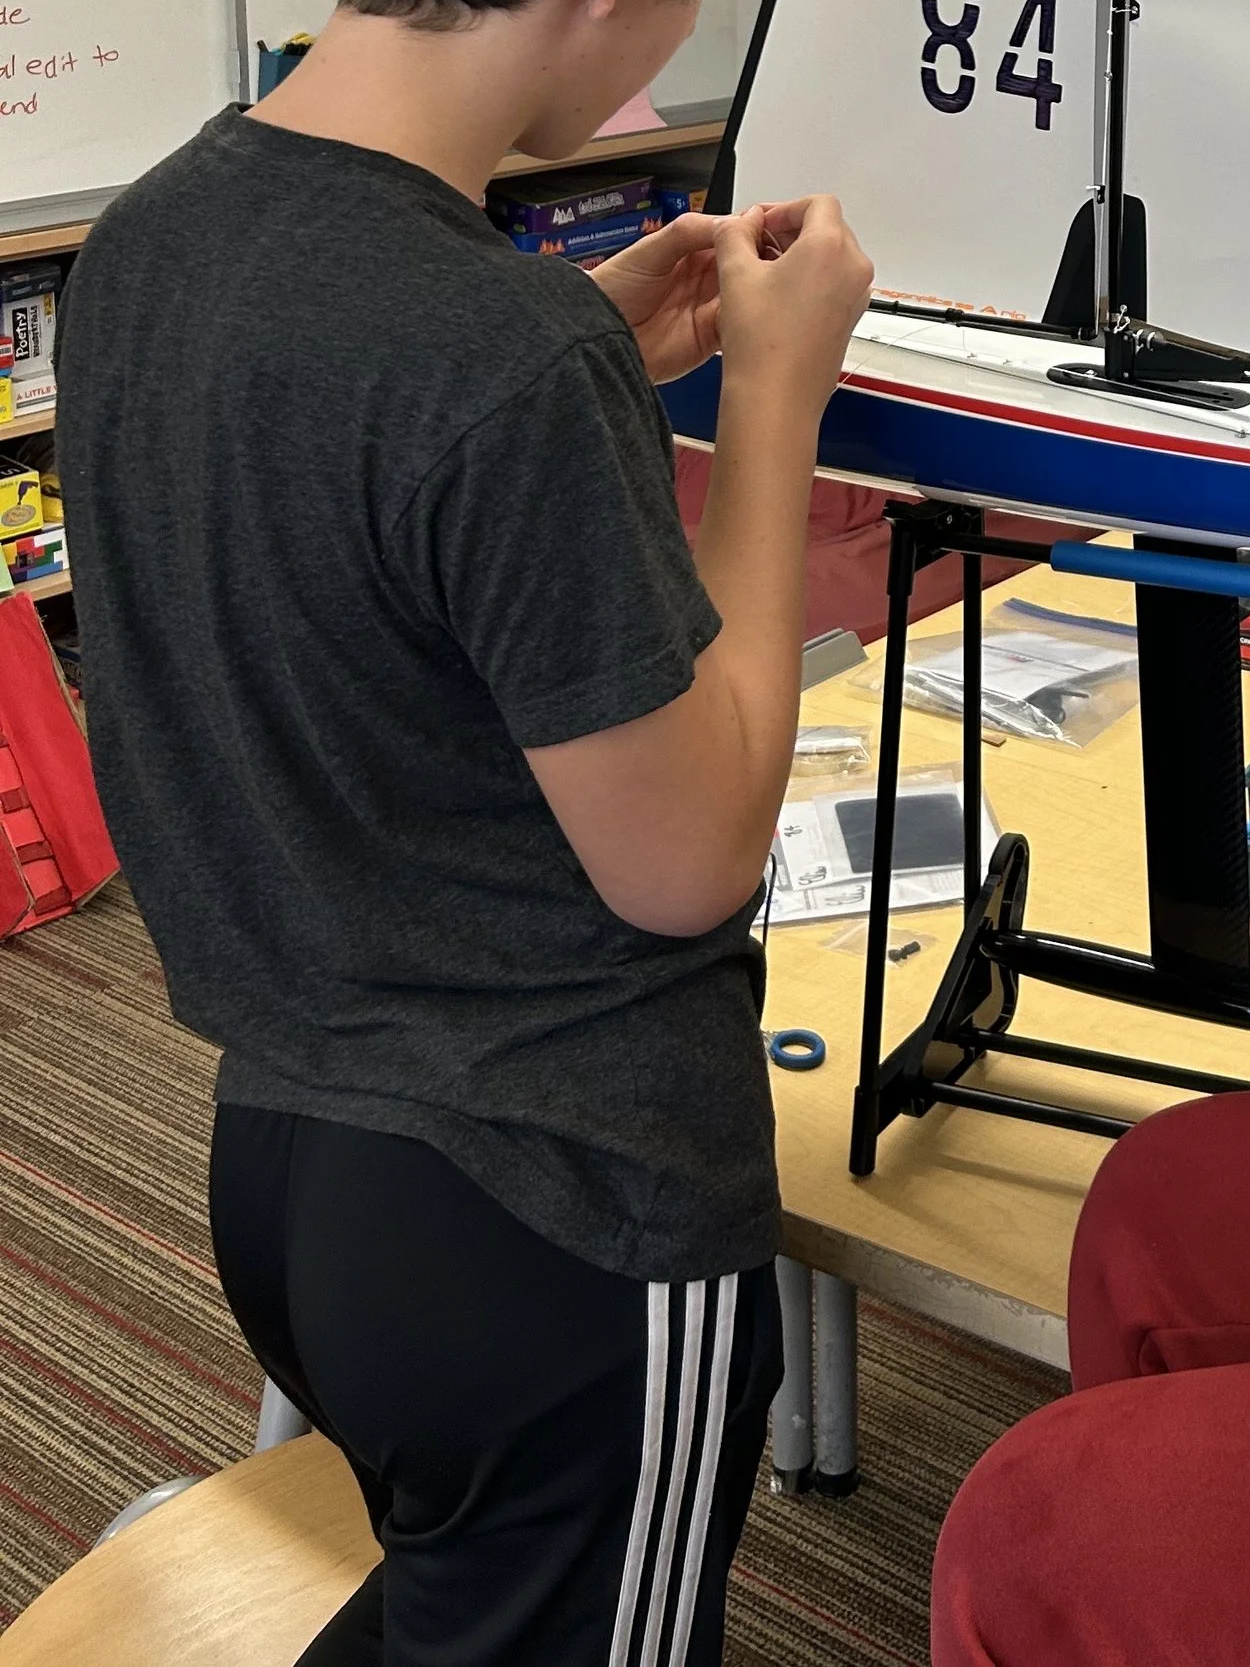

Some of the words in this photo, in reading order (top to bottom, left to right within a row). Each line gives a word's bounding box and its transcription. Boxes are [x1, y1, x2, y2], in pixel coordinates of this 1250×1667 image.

[0, 6, 30, 25] de
[26, 51, 78, 78] edit
[93, 45, 119, 67] to
[872, 288, 952, 307] ragonflite
[16, 311, 29, 358] Poetry
